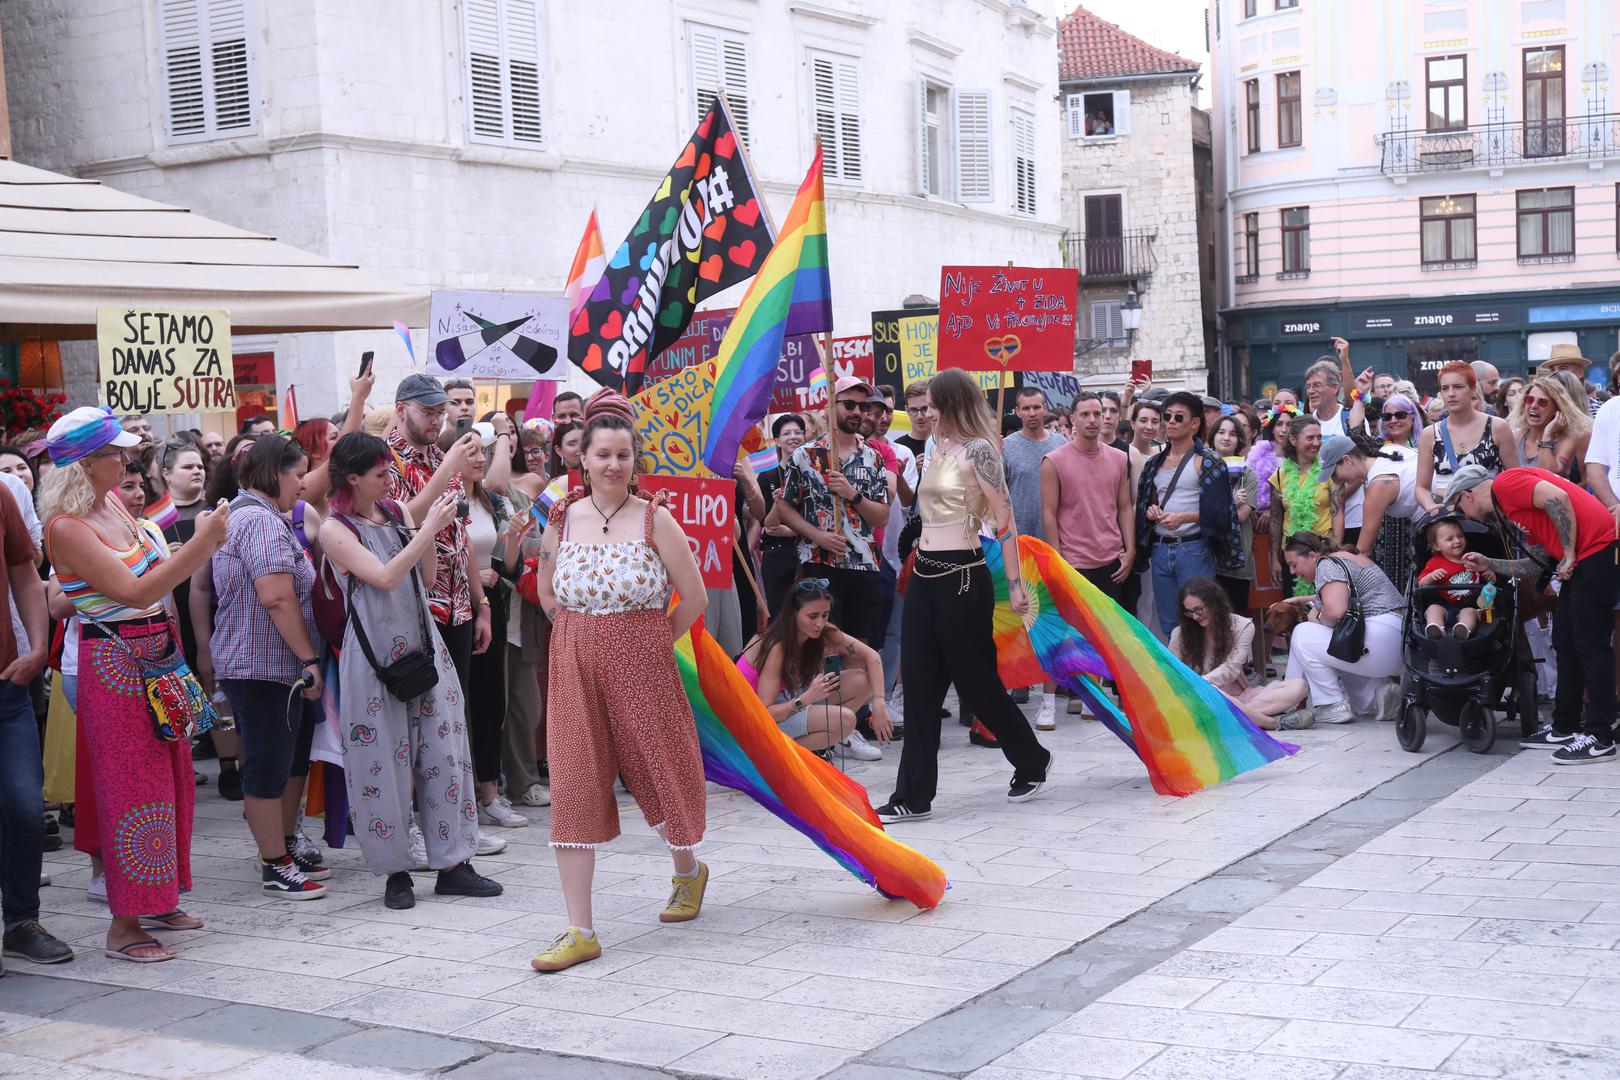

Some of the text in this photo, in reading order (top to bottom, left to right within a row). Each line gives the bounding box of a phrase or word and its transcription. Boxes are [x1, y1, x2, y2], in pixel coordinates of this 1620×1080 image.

[1016, 294, 1026, 310] 4
[123, 309, 213, 345] ŠETAMO
[438, 316, 478, 334] Nisam
[1284, 322, 1320, 333] znanje
[1414, 314, 1453, 325] znanje
[112, 347, 176, 376] DANAS
[192, 348, 222, 376] ZA
[913, 343, 933, 357] JE
[172, 376, 236, 408] SUTRA
[657, 371, 697, 405] SMO
[640, 416, 665, 441] MI
[682, 493, 728, 527] LIPO
